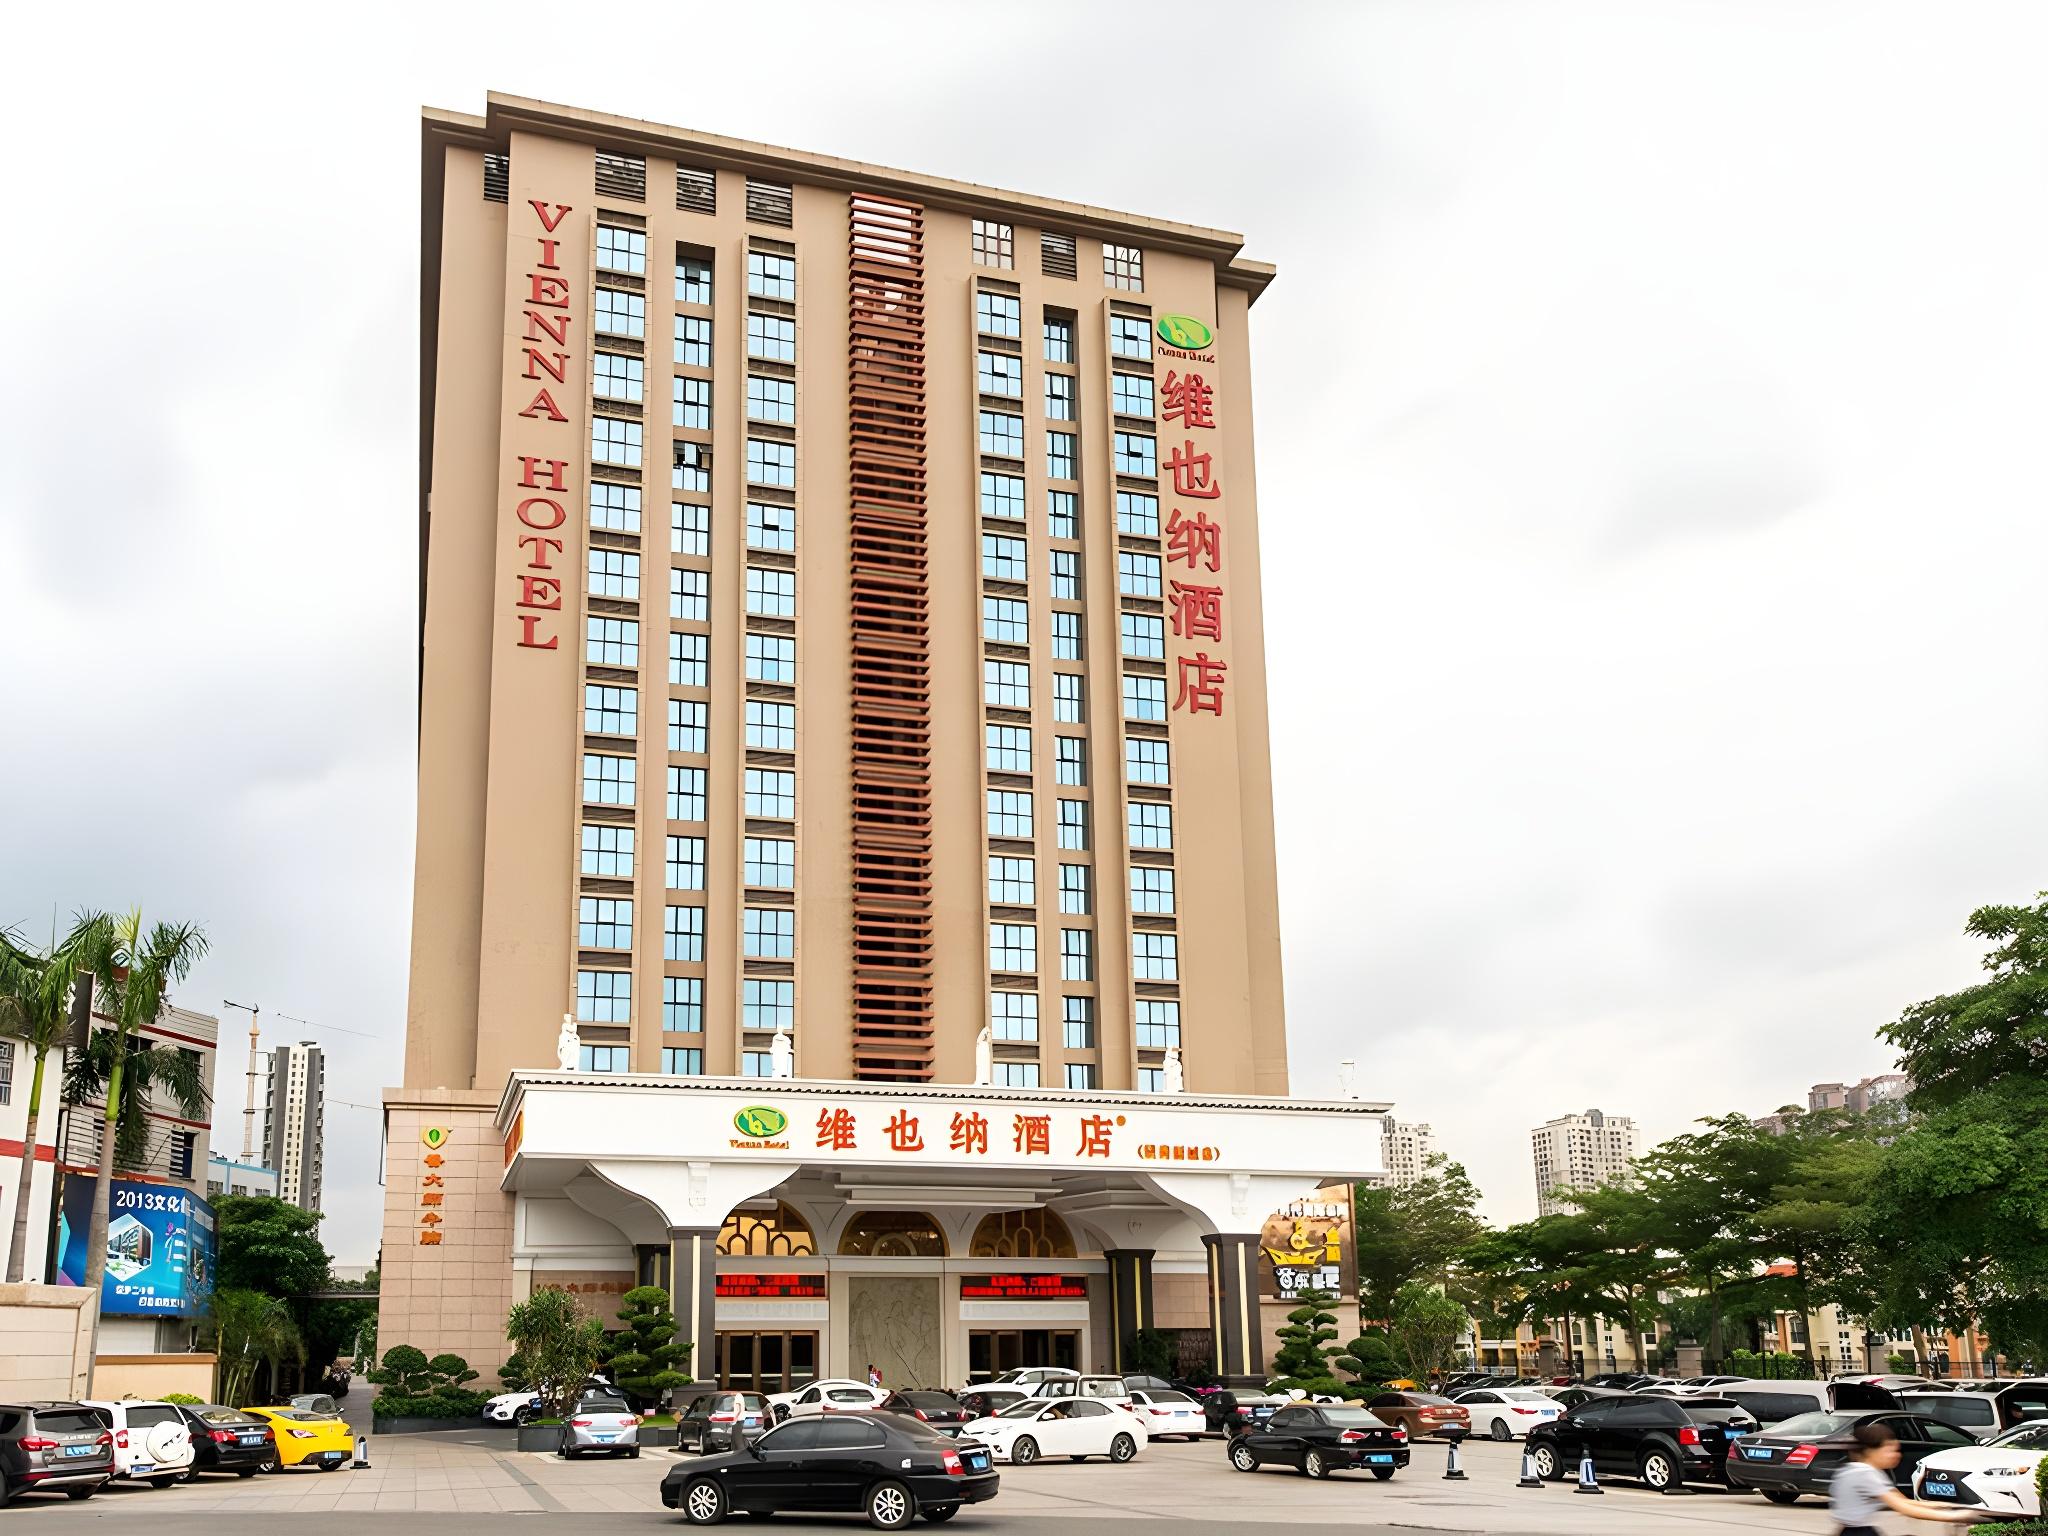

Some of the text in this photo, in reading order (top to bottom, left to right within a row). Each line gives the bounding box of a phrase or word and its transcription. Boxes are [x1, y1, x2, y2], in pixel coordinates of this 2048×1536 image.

[516, 200, 572, 650] VIENNA HOTEL
[1161, 370, 1227, 717] 维也纳酒店
[816, 1107, 1114, 1158] 维也纳酒店
